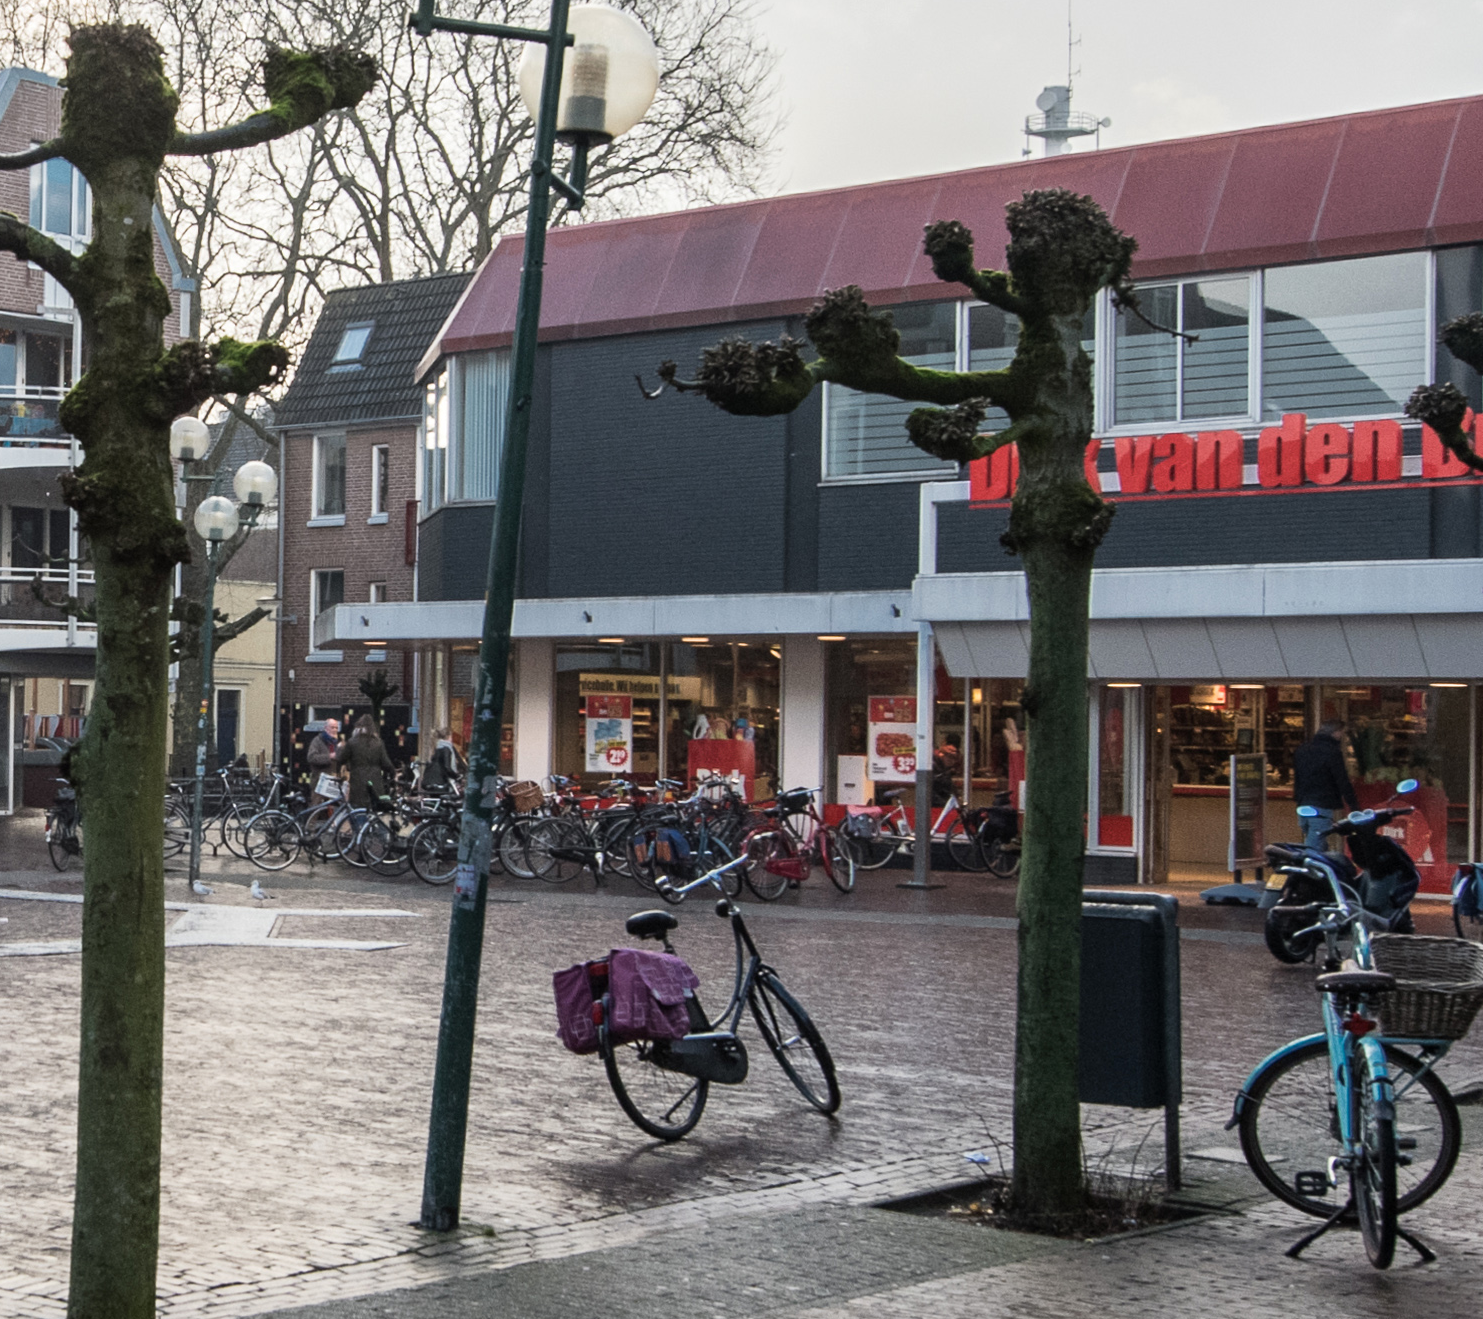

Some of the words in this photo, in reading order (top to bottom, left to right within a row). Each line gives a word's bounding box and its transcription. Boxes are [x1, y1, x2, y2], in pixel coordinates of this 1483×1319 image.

[970, 439, 1101, 501] Dk
[1115, 430, 1244, 494] van
[1258, 413, 1404, 487] den
